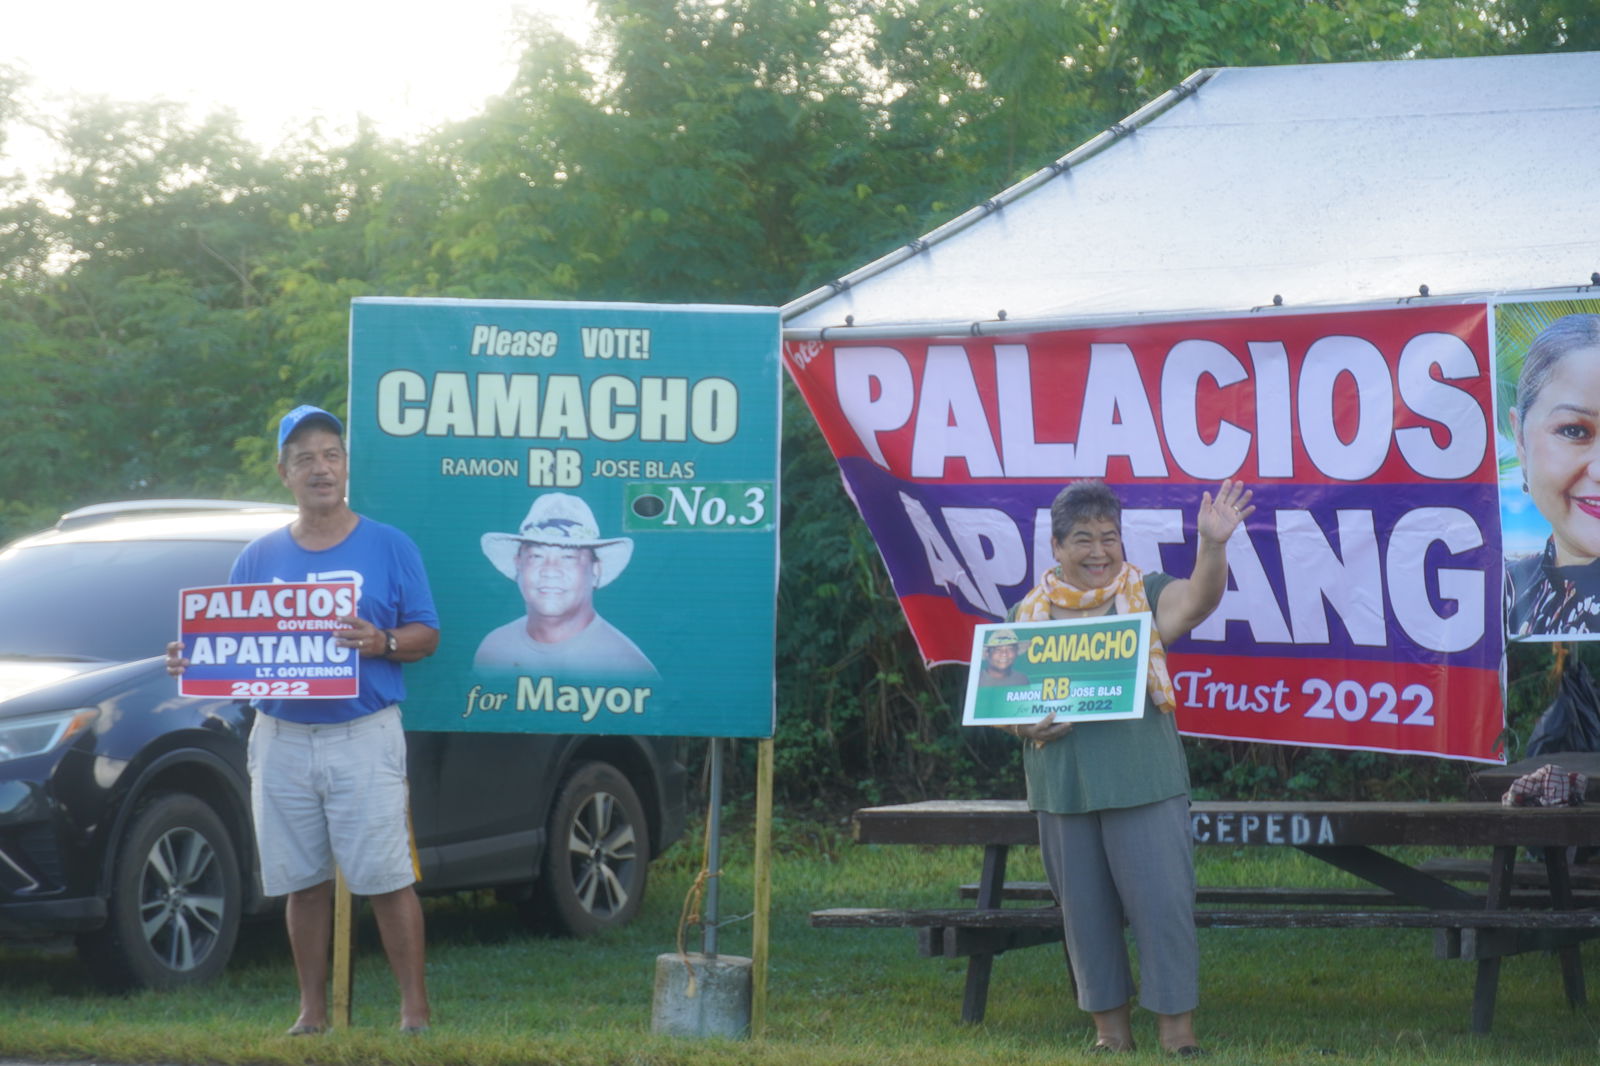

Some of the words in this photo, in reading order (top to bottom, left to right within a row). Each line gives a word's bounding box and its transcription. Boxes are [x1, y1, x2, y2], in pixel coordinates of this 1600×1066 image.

[470, 325, 558, 357] Please
[580, 327, 651, 360] VOTE!
[376, 369, 739, 444] CAMACHO
[832, 332, 1488, 481] PALACIOS
[441, 457, 519, 477] RAMON
[527, 447, 583, 488] RB
[592, 460, 640, 479] JOSE
[645, 461, 695, 480] BLAS
[663, 486, 766, 527] No.3
[184, 588, 353, 620] PALACIOS
[190, 635, 350, 665] APATANG
[1027, 628, 1138, 665] CAMACHO
[231, 681, 310, 696] 2022
[256, 668, 274, 678] LT.
[277, 666, 353, 678] GOVERNOR
[1006, 690, 1041, 702] RAMON
[1042, 677, 1070, 701] RB
[1071, 687, 1095, 698] JOSE
[1098, 685, 1122, 697] BLAS
[462, 686, 507, 718] for
[515, 677, 652, 721] Mayor
[1078, 699, 1113, 712] 2022
[1173, 667, 1291, 714] Trust
[1302, 678, 1435, 727] 2022
[1192, 813, 1336, 845] CEPEDA
